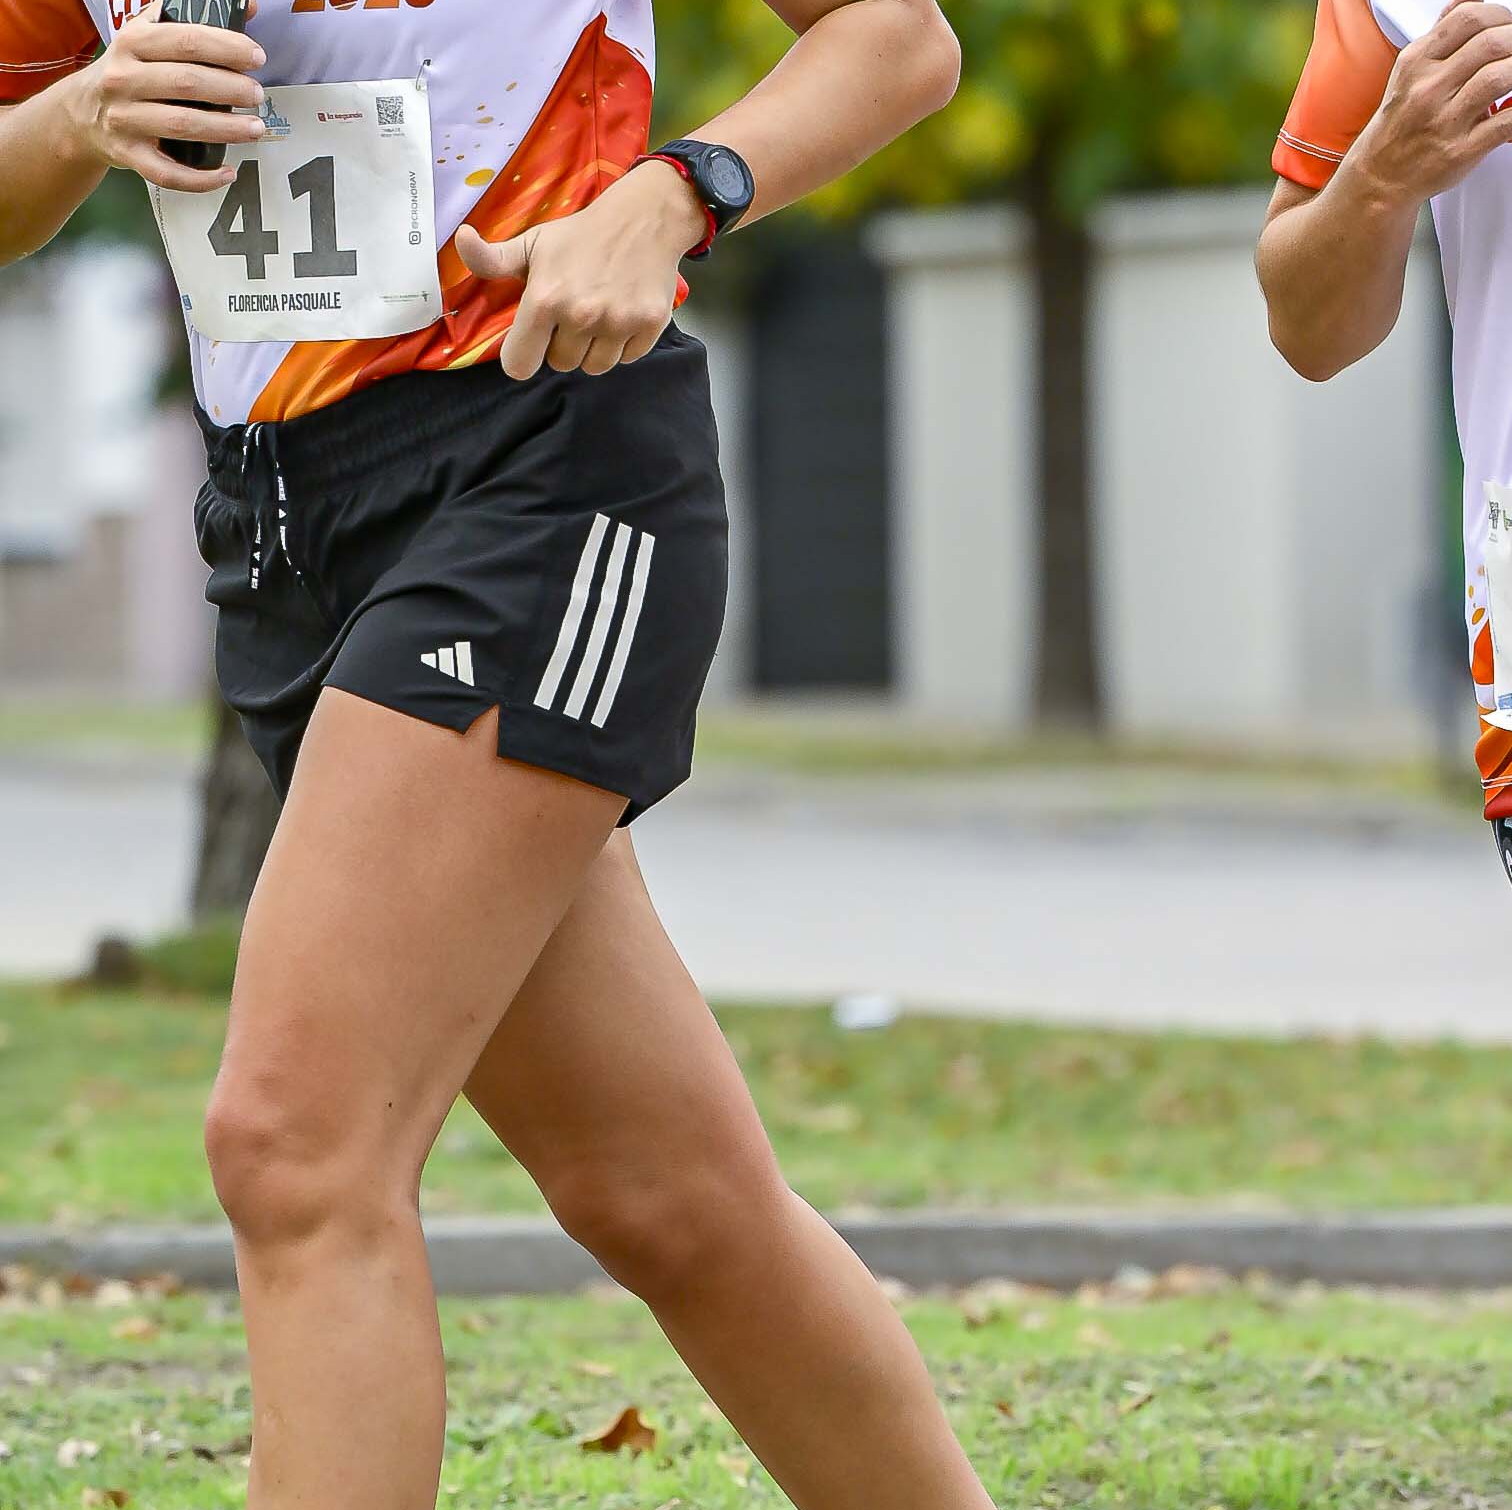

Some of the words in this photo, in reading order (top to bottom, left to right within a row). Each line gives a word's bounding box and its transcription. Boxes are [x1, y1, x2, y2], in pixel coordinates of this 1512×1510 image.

[207, 156, 358, 280] 41
[229, 294, 279, 312] FLORENCIA
[281, 292, 342, 311] PASQUALE
